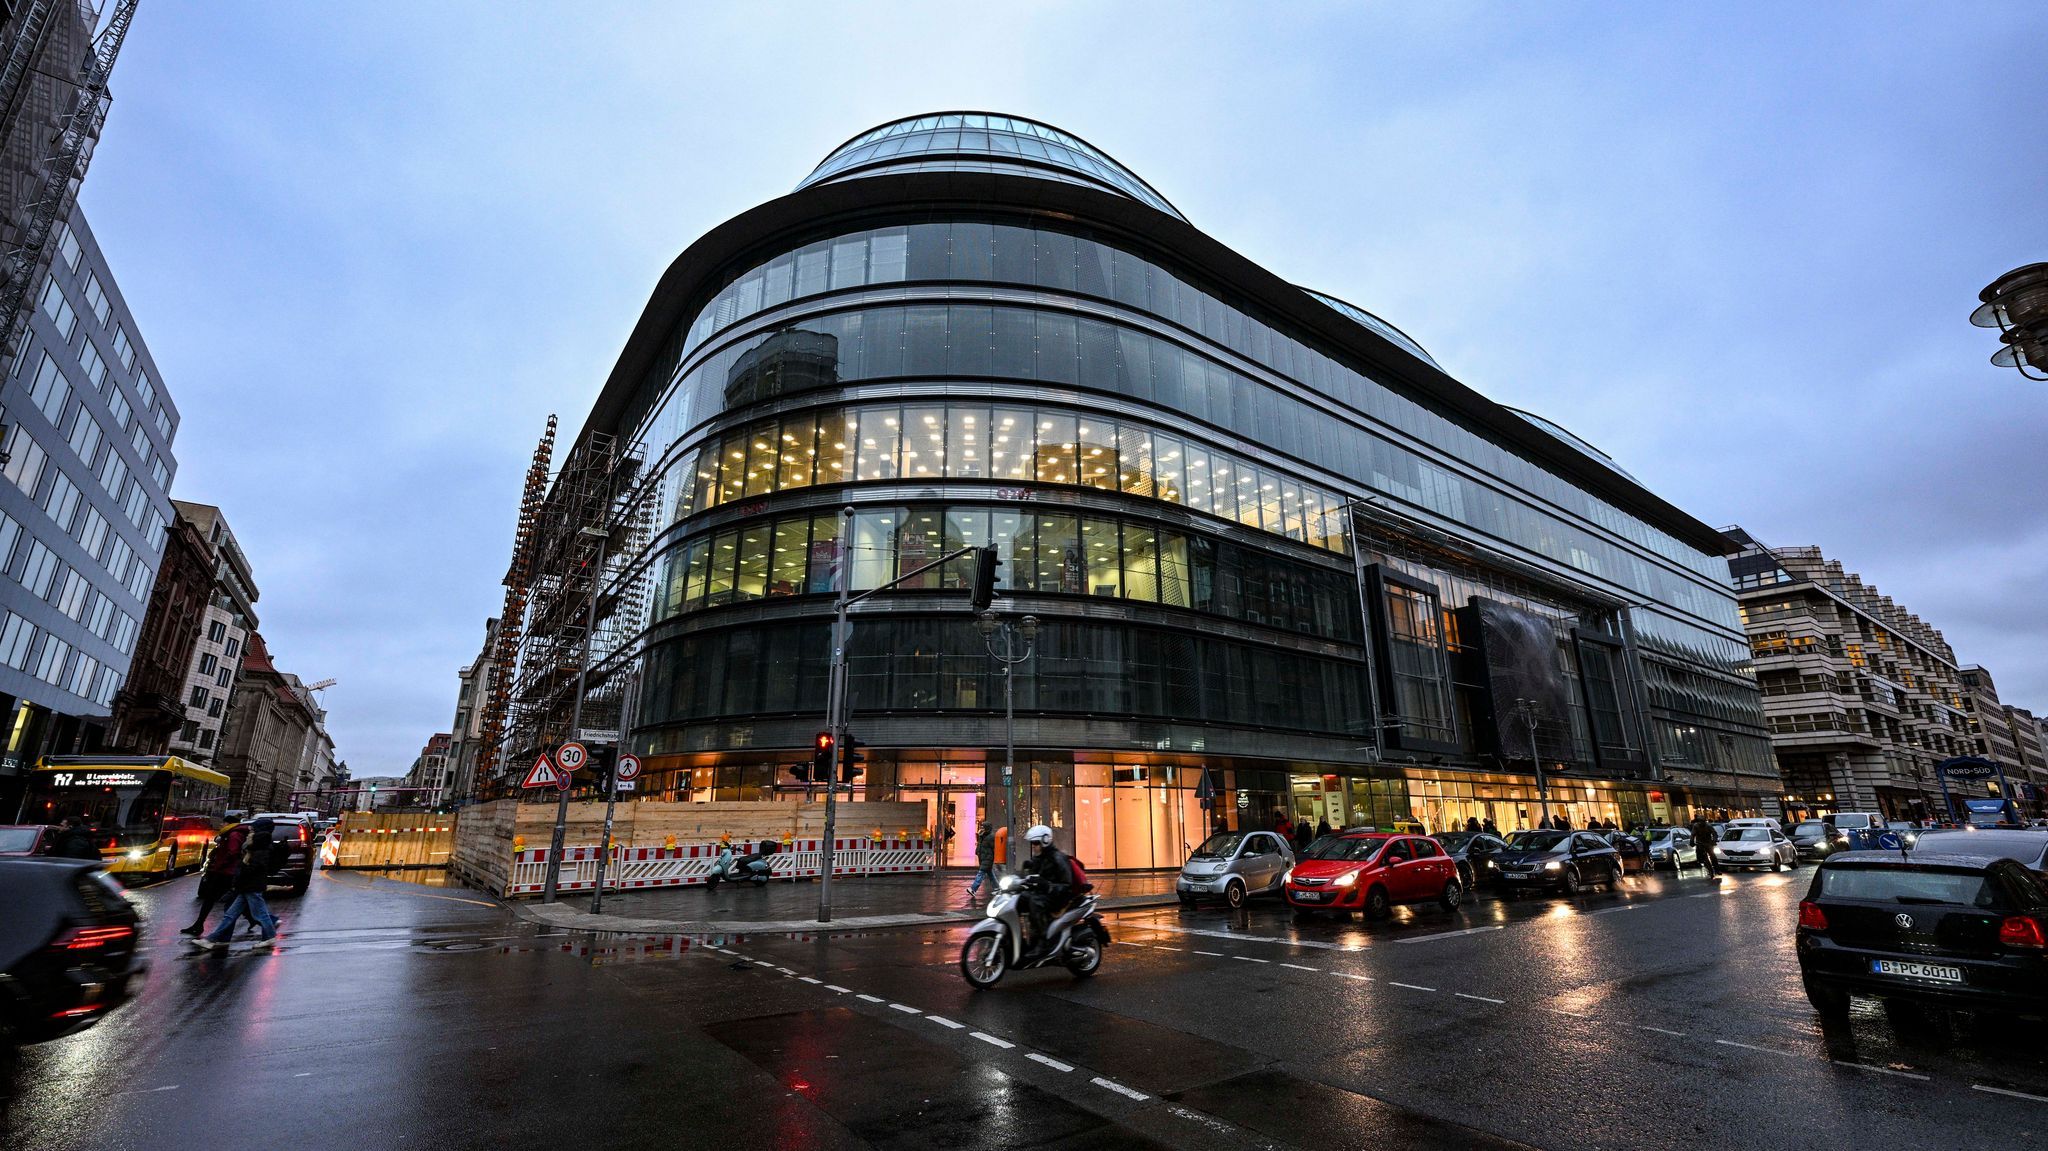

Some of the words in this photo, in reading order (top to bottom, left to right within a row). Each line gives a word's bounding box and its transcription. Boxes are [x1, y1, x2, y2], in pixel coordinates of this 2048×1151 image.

[562, 750, 580, 763] 30
[1881, 962, 1891, 972] B
[1901, 963, 1919, 975] PC
[1922, 965, 1960, 980] 6010
